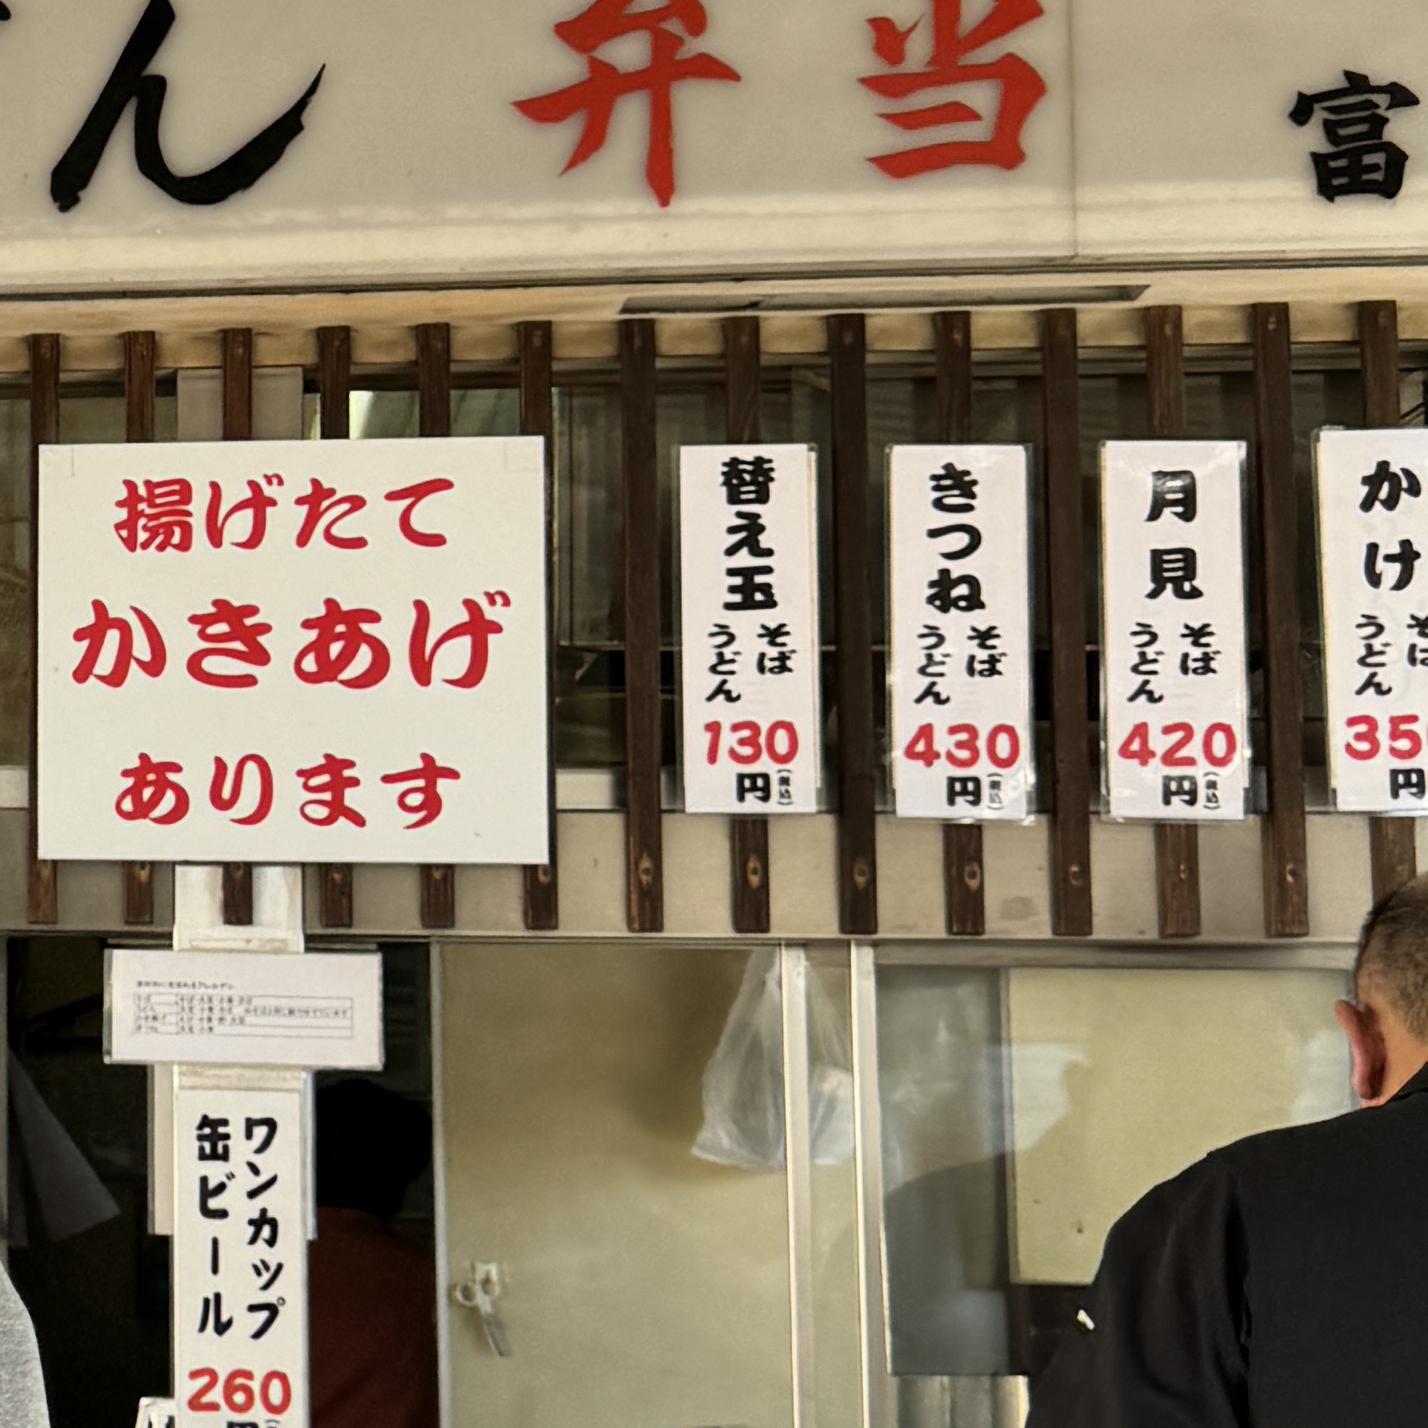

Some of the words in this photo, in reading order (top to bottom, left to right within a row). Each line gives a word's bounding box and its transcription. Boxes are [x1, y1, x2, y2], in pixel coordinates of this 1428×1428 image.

[1286, 68, 1421, 204] 富
[113, 473, 454, 553] 揚げたて
[720, 455, 779, 612] 替え玉
[925, 462, 987, 614] きつね
[1145, 469, 1204, 600] 月見
[1359, 459, 1422, 592] かけ
[71, 591, 511, 690] かきあげ
[705, 623, 742, 704] うどん
[756, 622, 797, 676] そば
[913, 624, 951, 706] うどん
[965, 625, 1007, 678] そば
[1127, 622, 1165, 704] うどん
[1179, 622, 1221, 676] そば
[1354, 613, 1393, 696] うどん
[704, 720, 799, 766] 130
[903, 723, 1020, 769] 430
[1118, 721, 1237, 768] 420
[1344, 714, 1428, 761] 35
[114, 753, 460, 830] あります
[736, 772, 772, 804] 円
[946, 775, 982, 807] 円
[1162, 775, 1198, 807] 円
[1389, 767, 1426, 800] 円
[195, 1114, 236, 1337] 缶ビール
[244, 1117, 286, 1340] ワンカップ
[186, 1367, 291, 1416] 260
